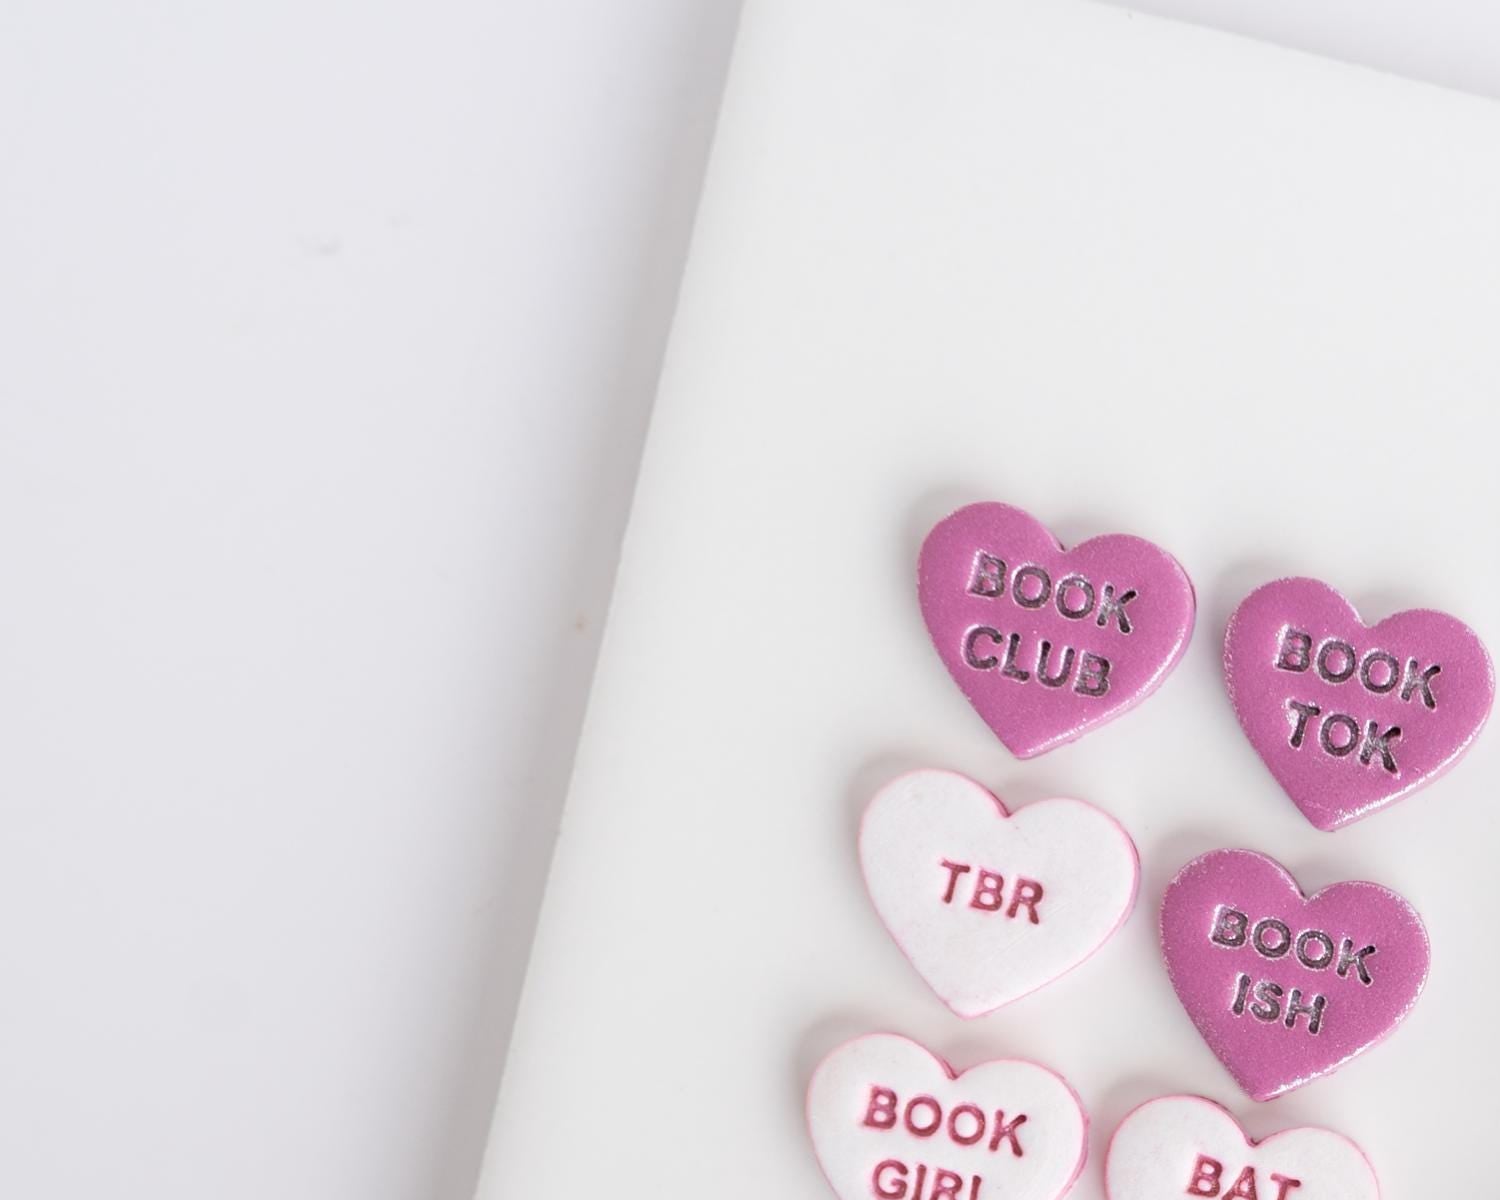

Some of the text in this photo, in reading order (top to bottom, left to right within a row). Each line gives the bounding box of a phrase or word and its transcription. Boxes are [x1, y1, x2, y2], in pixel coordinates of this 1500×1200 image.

[968, 551, 1137, 634] BOOK
[961, 625, 1113, 697] CLUB
[1275, 625, 1442, 710] BOOK
[1285, 699, 1401, 775] TOK
[938, 857, 1046, 925] TBR
[1210, 904, 1377, 985] BOOK
[1231, 973, 1328, 1035] ISH
[862, 1085, 1028, 1158] BOOK
